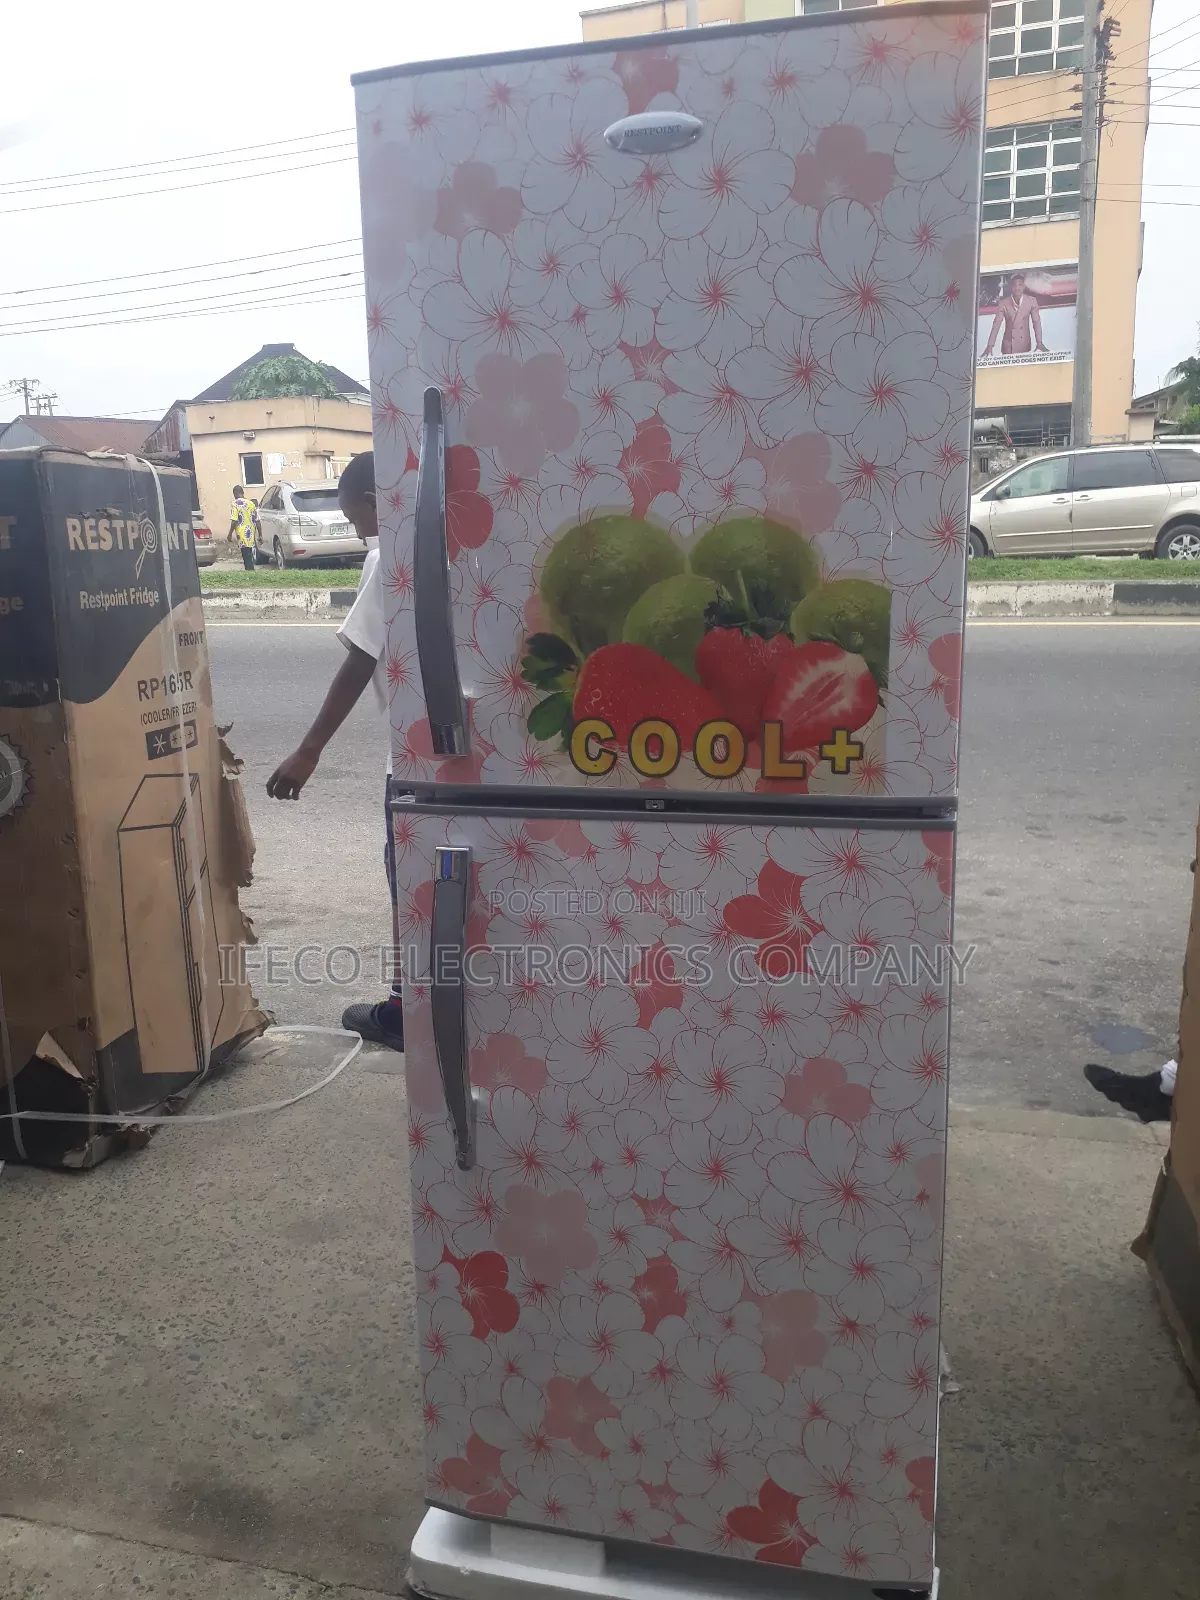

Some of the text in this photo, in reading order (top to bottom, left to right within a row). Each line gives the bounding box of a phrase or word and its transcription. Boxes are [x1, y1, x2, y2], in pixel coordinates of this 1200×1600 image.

[623, 124, 682, 138] RESTPOINT
[66, 517, 190, 554] RESTPONT
[80, 586, 160, 611] Restpoint Fridge
[179, 630, 204, 647] FRONT
[137, 670, 194, 702] RP165R
[140, 701, 197, 727] (COOLER/FREZER)
